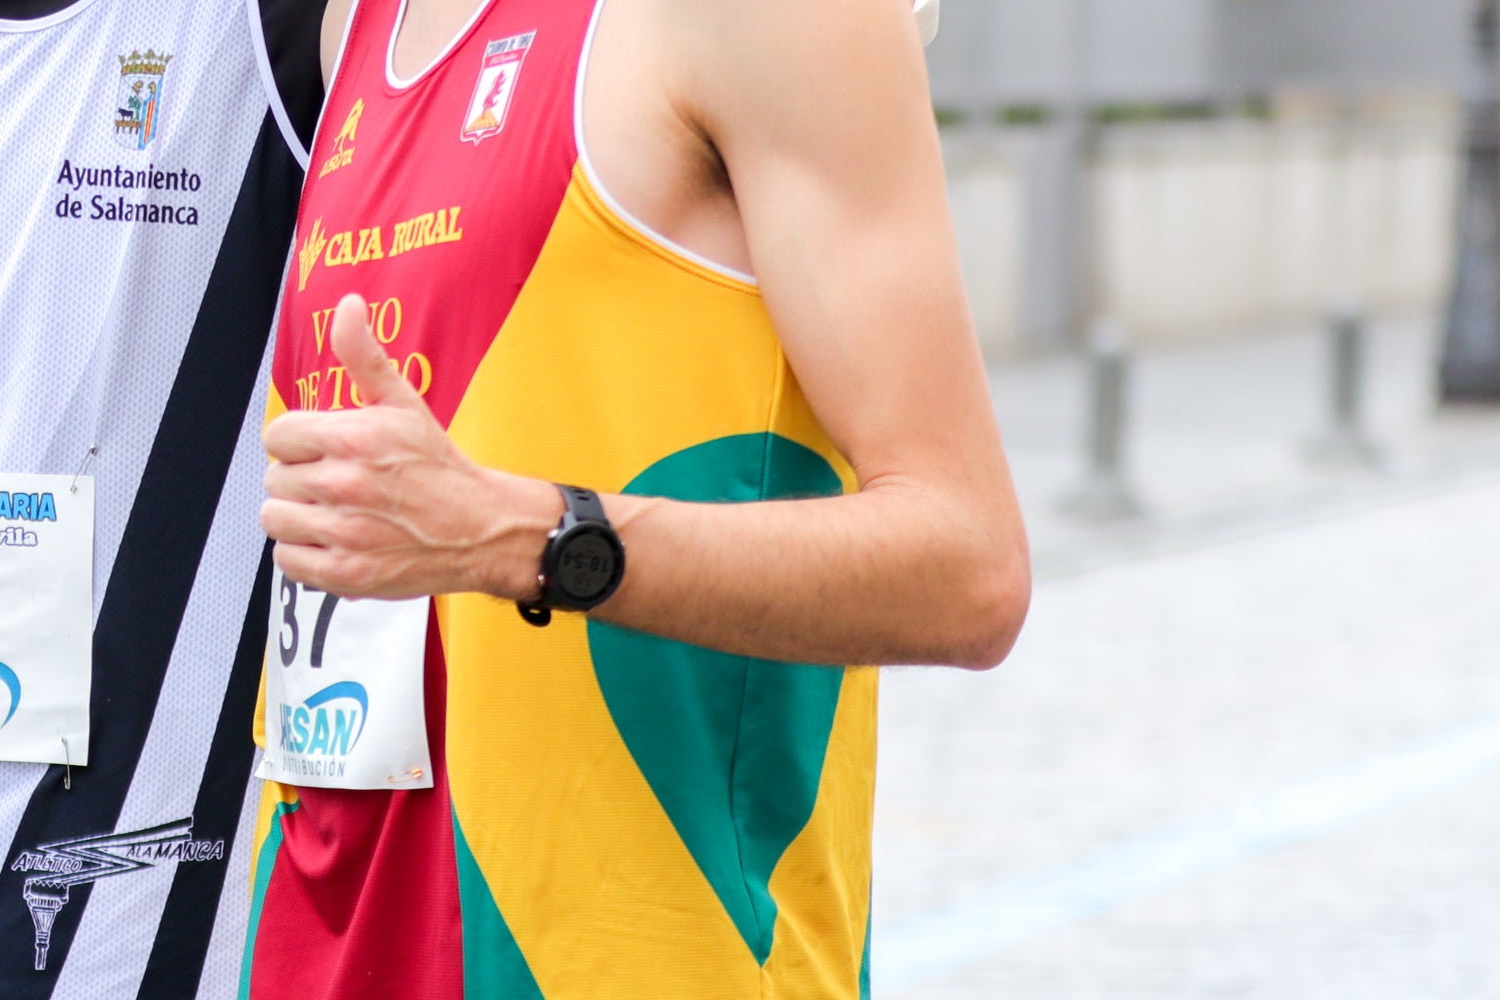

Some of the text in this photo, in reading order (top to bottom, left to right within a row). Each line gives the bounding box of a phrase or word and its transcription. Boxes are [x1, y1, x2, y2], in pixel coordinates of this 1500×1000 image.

[57, 159, 201, 192] Ayuntamiento
[55, 193, 199, 226] de Salamanca
[324, 206, 463, 268] CAJA RURAL
[295, 371, 320, 413] DE
[280, 574, 341, 668] 37
[280, 703, 357, 756] HESAN
